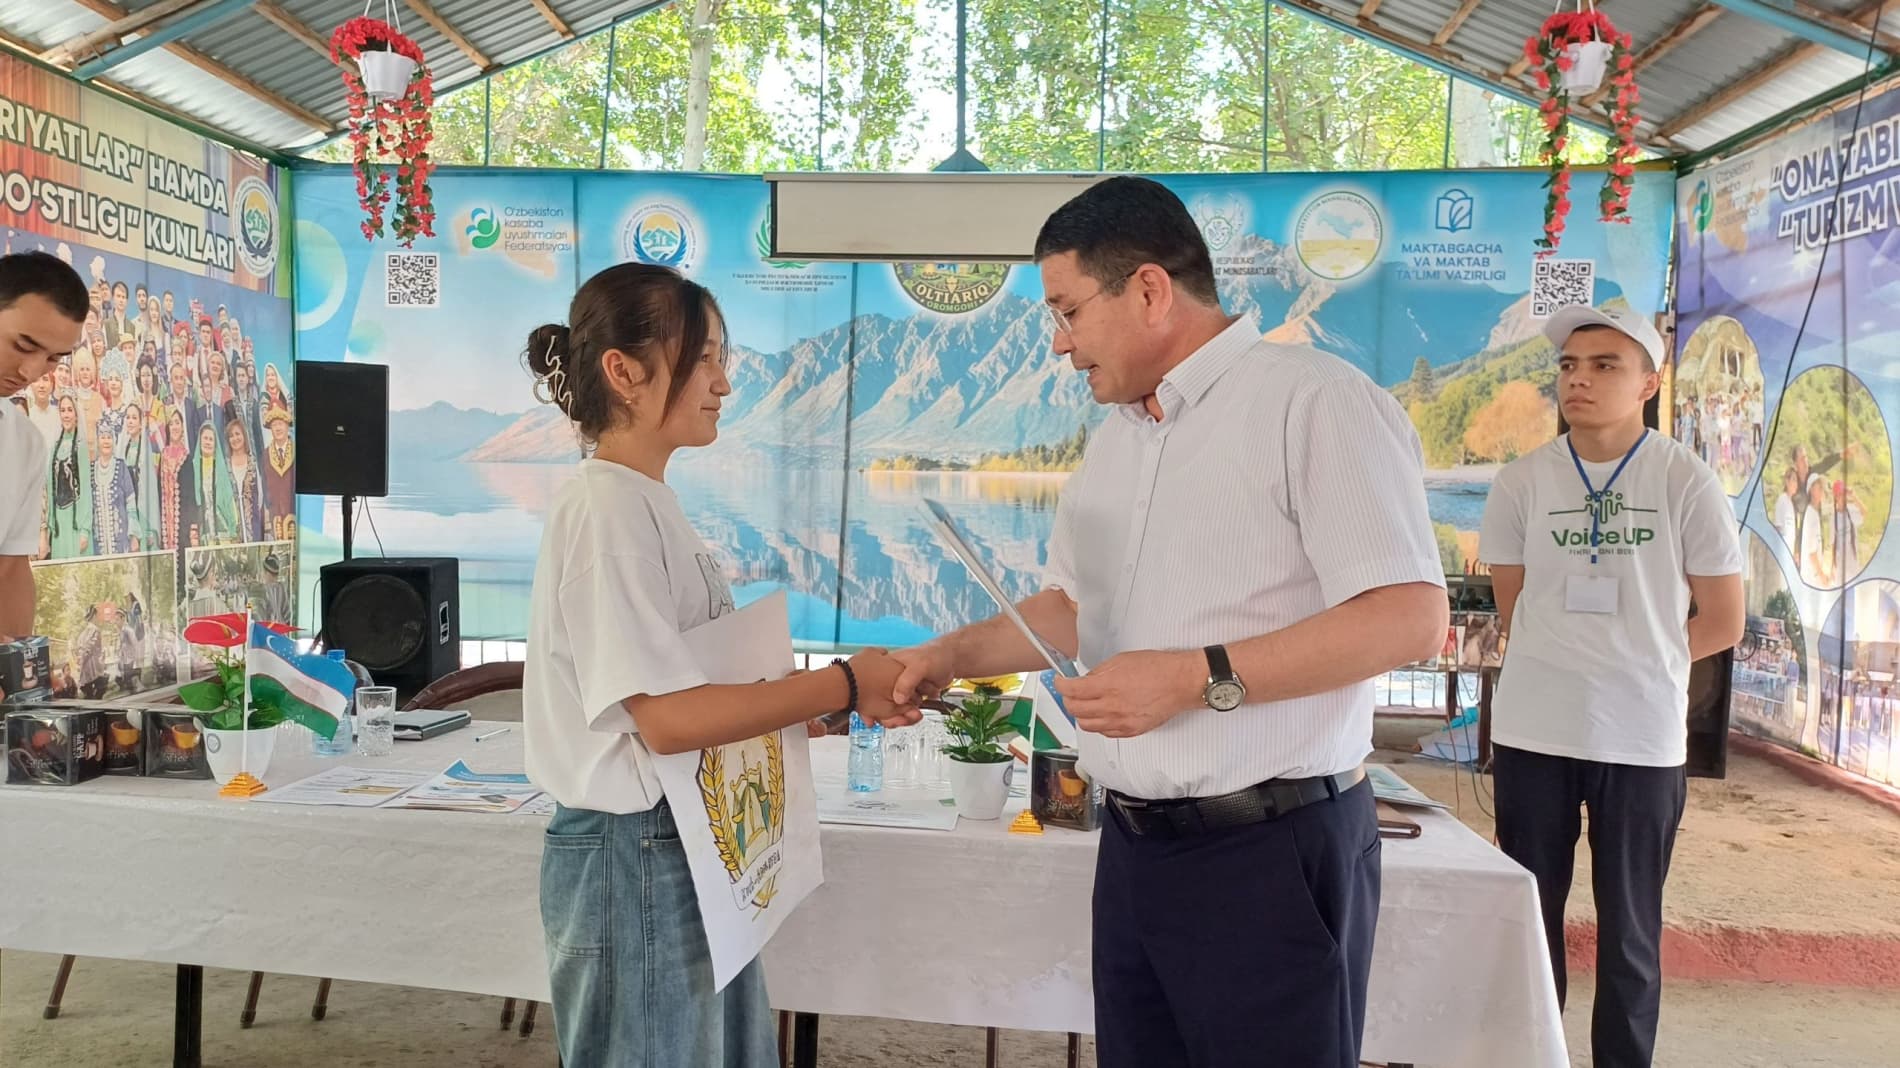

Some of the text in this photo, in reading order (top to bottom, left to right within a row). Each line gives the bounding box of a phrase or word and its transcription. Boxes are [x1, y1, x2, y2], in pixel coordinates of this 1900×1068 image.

[149, 155, 229, 216] HAMDA
[1771, 144, 1836, 199] "ONA
[0, 170, 141, 242] O'STLIGI"
[145, 211, 235, 272] KUNLARI
[1779, 183, 1888, 251] "TURIZM
[1401, 243, 1503, 254] MAKTABGACHA
[1413, 257, 1491, 267] VA MAKTAB
[1444, 270, 1506, 280] VAZIRLIGI
[916, 284, 990, 304] OLTIARIQ
